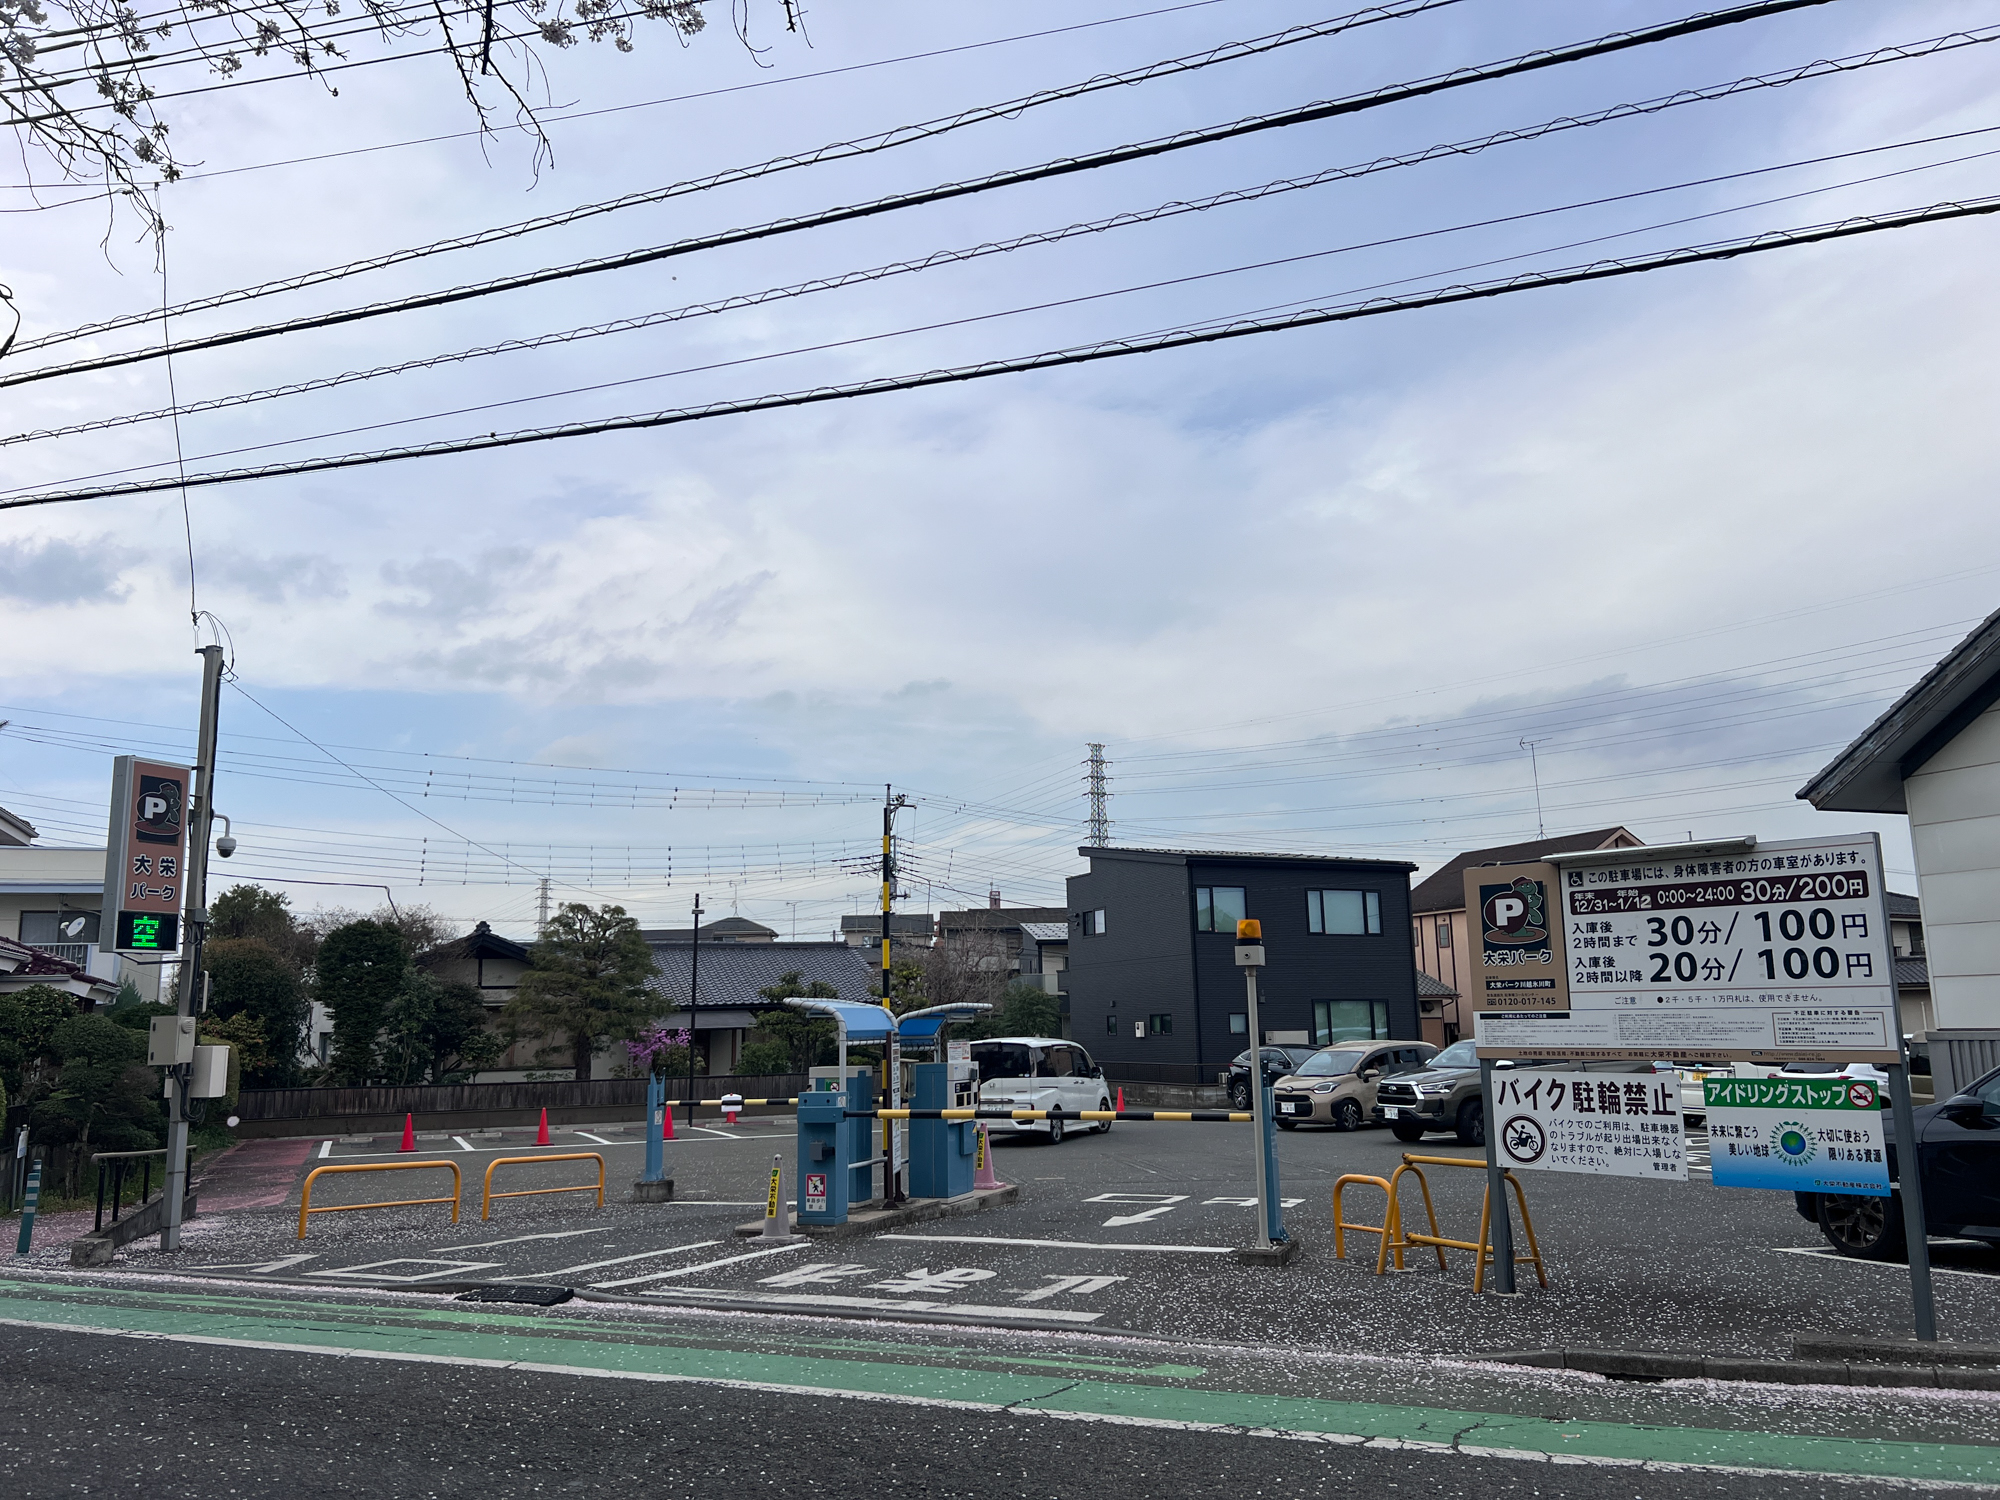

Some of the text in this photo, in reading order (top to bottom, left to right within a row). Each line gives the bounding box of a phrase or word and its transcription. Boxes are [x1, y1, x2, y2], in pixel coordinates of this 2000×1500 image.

[144, 797, 167, 819] P
[133, 854, 177, 877] 大栄
[1588, 851, 1866, 883] この駐車場には、身体障害者の方の車室があります。
[130, 883, 175, 901] パーク
[1573, 889, 1639, 900] 年末 年始
[1495, 898, 1524, 926] P
[132, 916, 159, 947] 空
[1572, 921, 1613, 934] 入庫後
[1573, 935, 1638, 948] 2時間まで
[1483, 949, 1552, 967] 大栄パーク
[1575, 956, 1616, 969] 入庫後
[1576, 970, 1643, 983] 2時間以降
[1498, 997, 1556, 1006] 0120-017-145
[1614, 997, 1637, 1005] ご注意
[1498, 1078, 1676, 1116] バイク駐輪禁止
[1707, 1083, 1846, 1106] アイドリングストップ
[1549, 1119, 1679, 1134] バイクでのご利用は、駐車機器
[1711, 1125, 1759, 1139] 未来に繋ごう
[1550, 1131, 1679, 1146] のトラブルが起り出場出来なく
[1817, 1128, 1870, 1144] 大切に使おう
[1551, 1143, 1681, 1159] なりますので、絶対に入場しな
[1728, 1143, 1769, 1157] 美しい地球
[1828, 1148, 1882, 1163] 限りある資源
[1552, 1155, 1610, 1168] いでください。
[1653, 1162, 1677, 1172] 管理者
[1823, 1181, 1882, 1190] 大栄不動産株式会社
